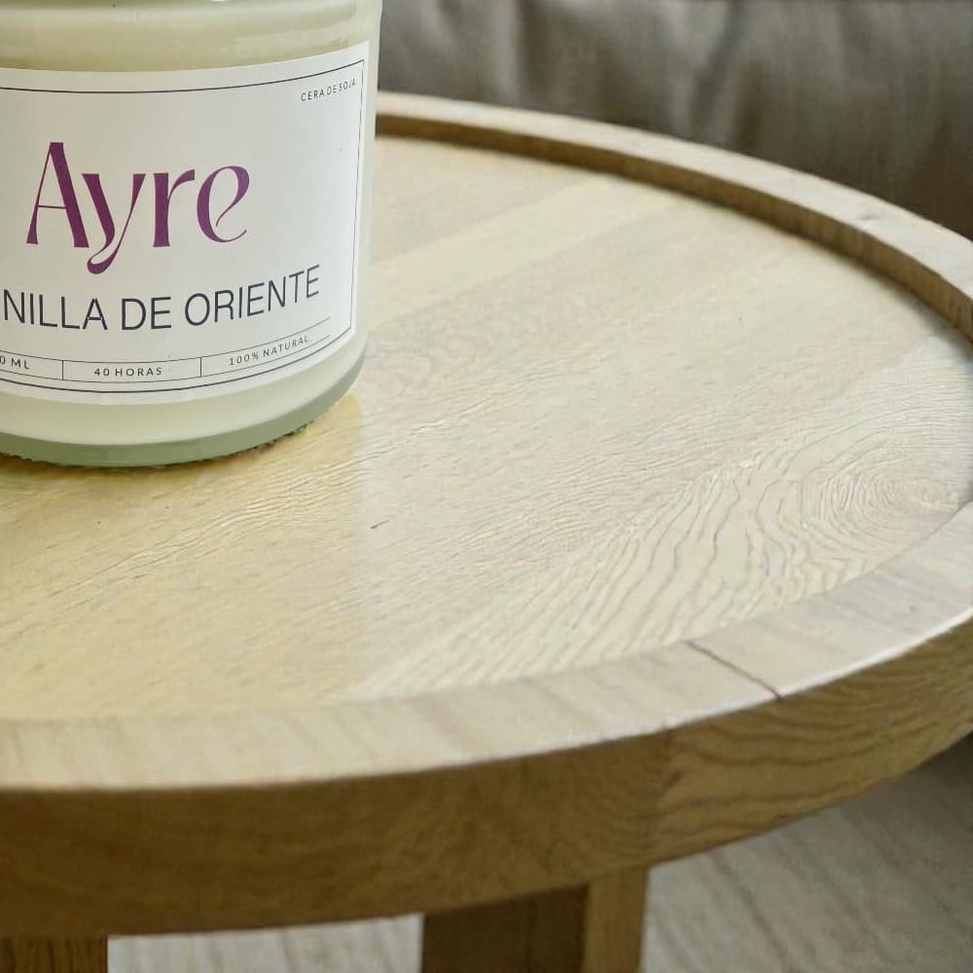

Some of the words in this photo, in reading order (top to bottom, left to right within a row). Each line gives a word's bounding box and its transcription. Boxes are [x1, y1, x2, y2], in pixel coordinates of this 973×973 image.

[301, 88, 325, 102] CERA
[327, 85, 337, 96] DE
[339, 77, 356, 91] SOJA
[26, 142, 250, 275] Ayre
[121, 296, 173, 331] DE
[185, 264, 320, 327] ORIENTE
[10, 357, 31, 370] ML
[229, 351, 260, 366] 100%
[262, 335, 309, 358] NATURAL
[94, 367, 110, 377] 40
[114, 366, 163, 377] HORAS
